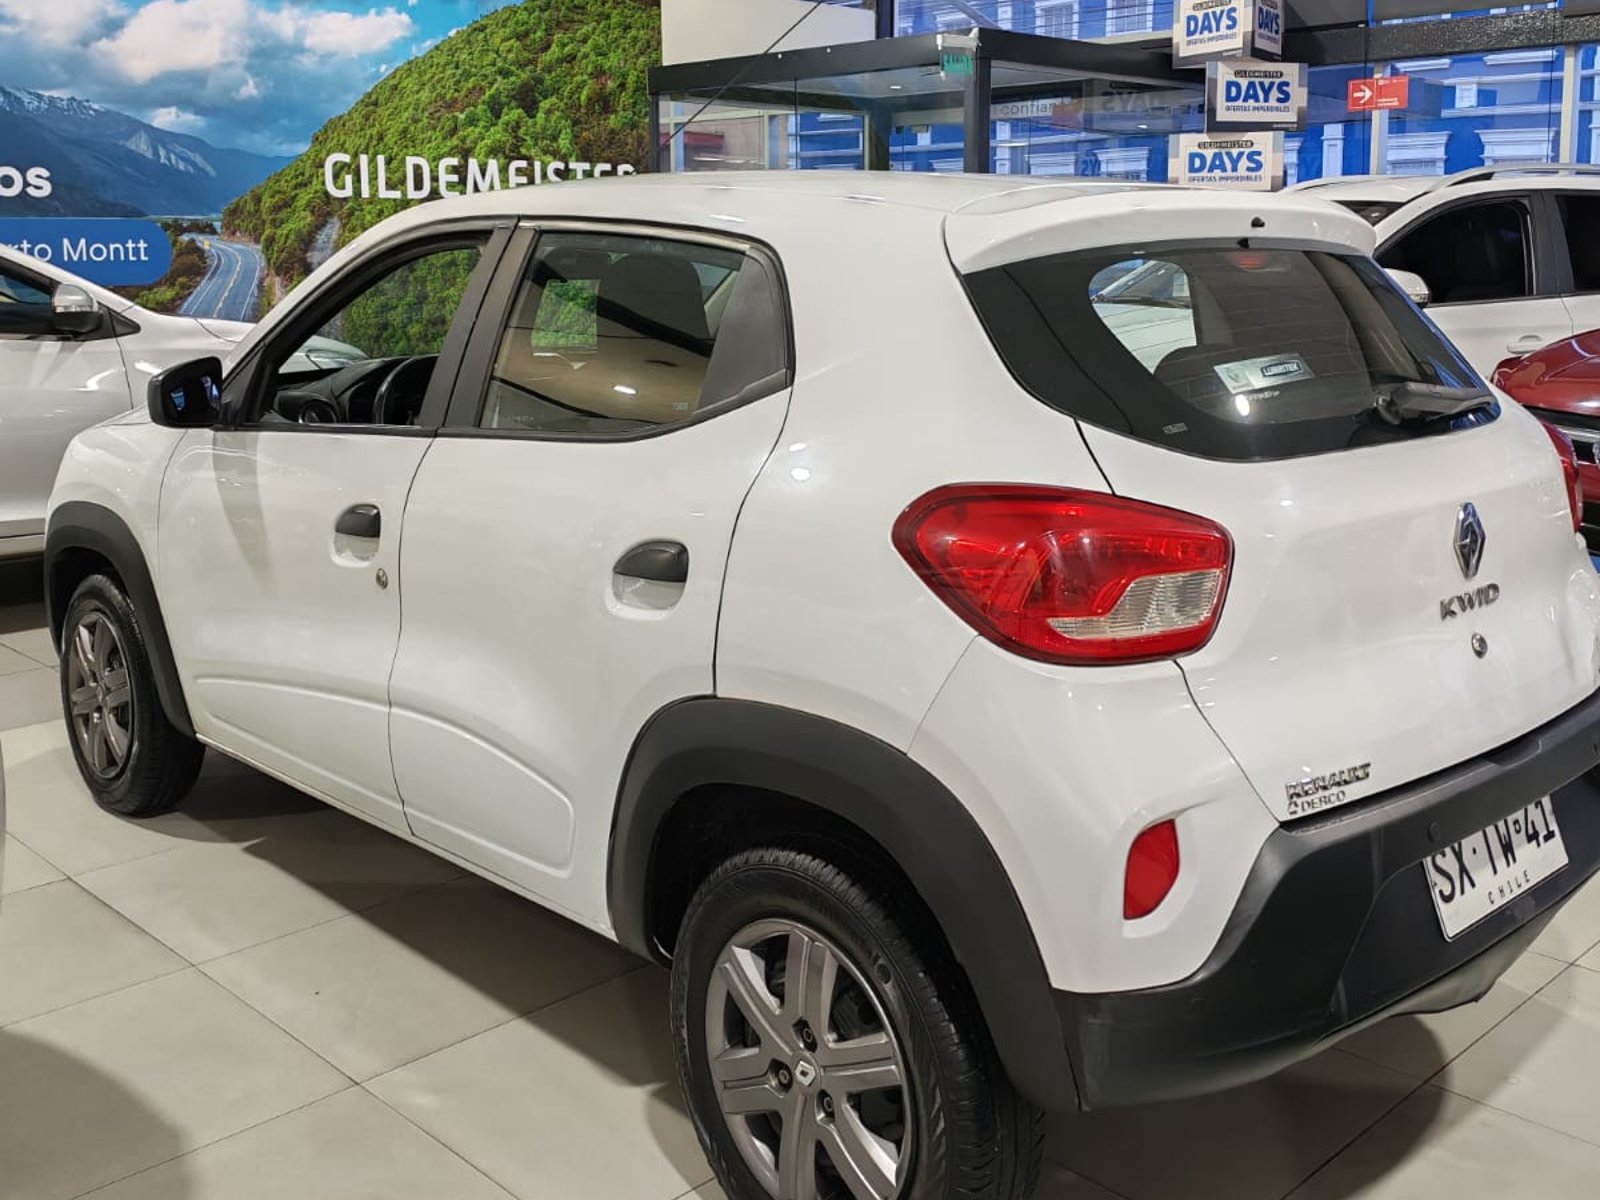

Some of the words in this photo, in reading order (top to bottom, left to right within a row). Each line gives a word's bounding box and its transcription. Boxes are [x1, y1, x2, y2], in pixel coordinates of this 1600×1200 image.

[1186, 7, 1237, 38] DAYS
[1258, 6, 1280, 35] DAYS
[1225, 80, 1291, 103] DAYS
[1188, 151, 1264, 174] DAYS
[63, 238, 149, 262] Montt
[1440, 583, 1500, 620] KWID
[1285, 762, 1371, 800] RENAULT
[1301, 790, 1346, 812] DERCO
[1488, 869, 1531, 905] CHILE
